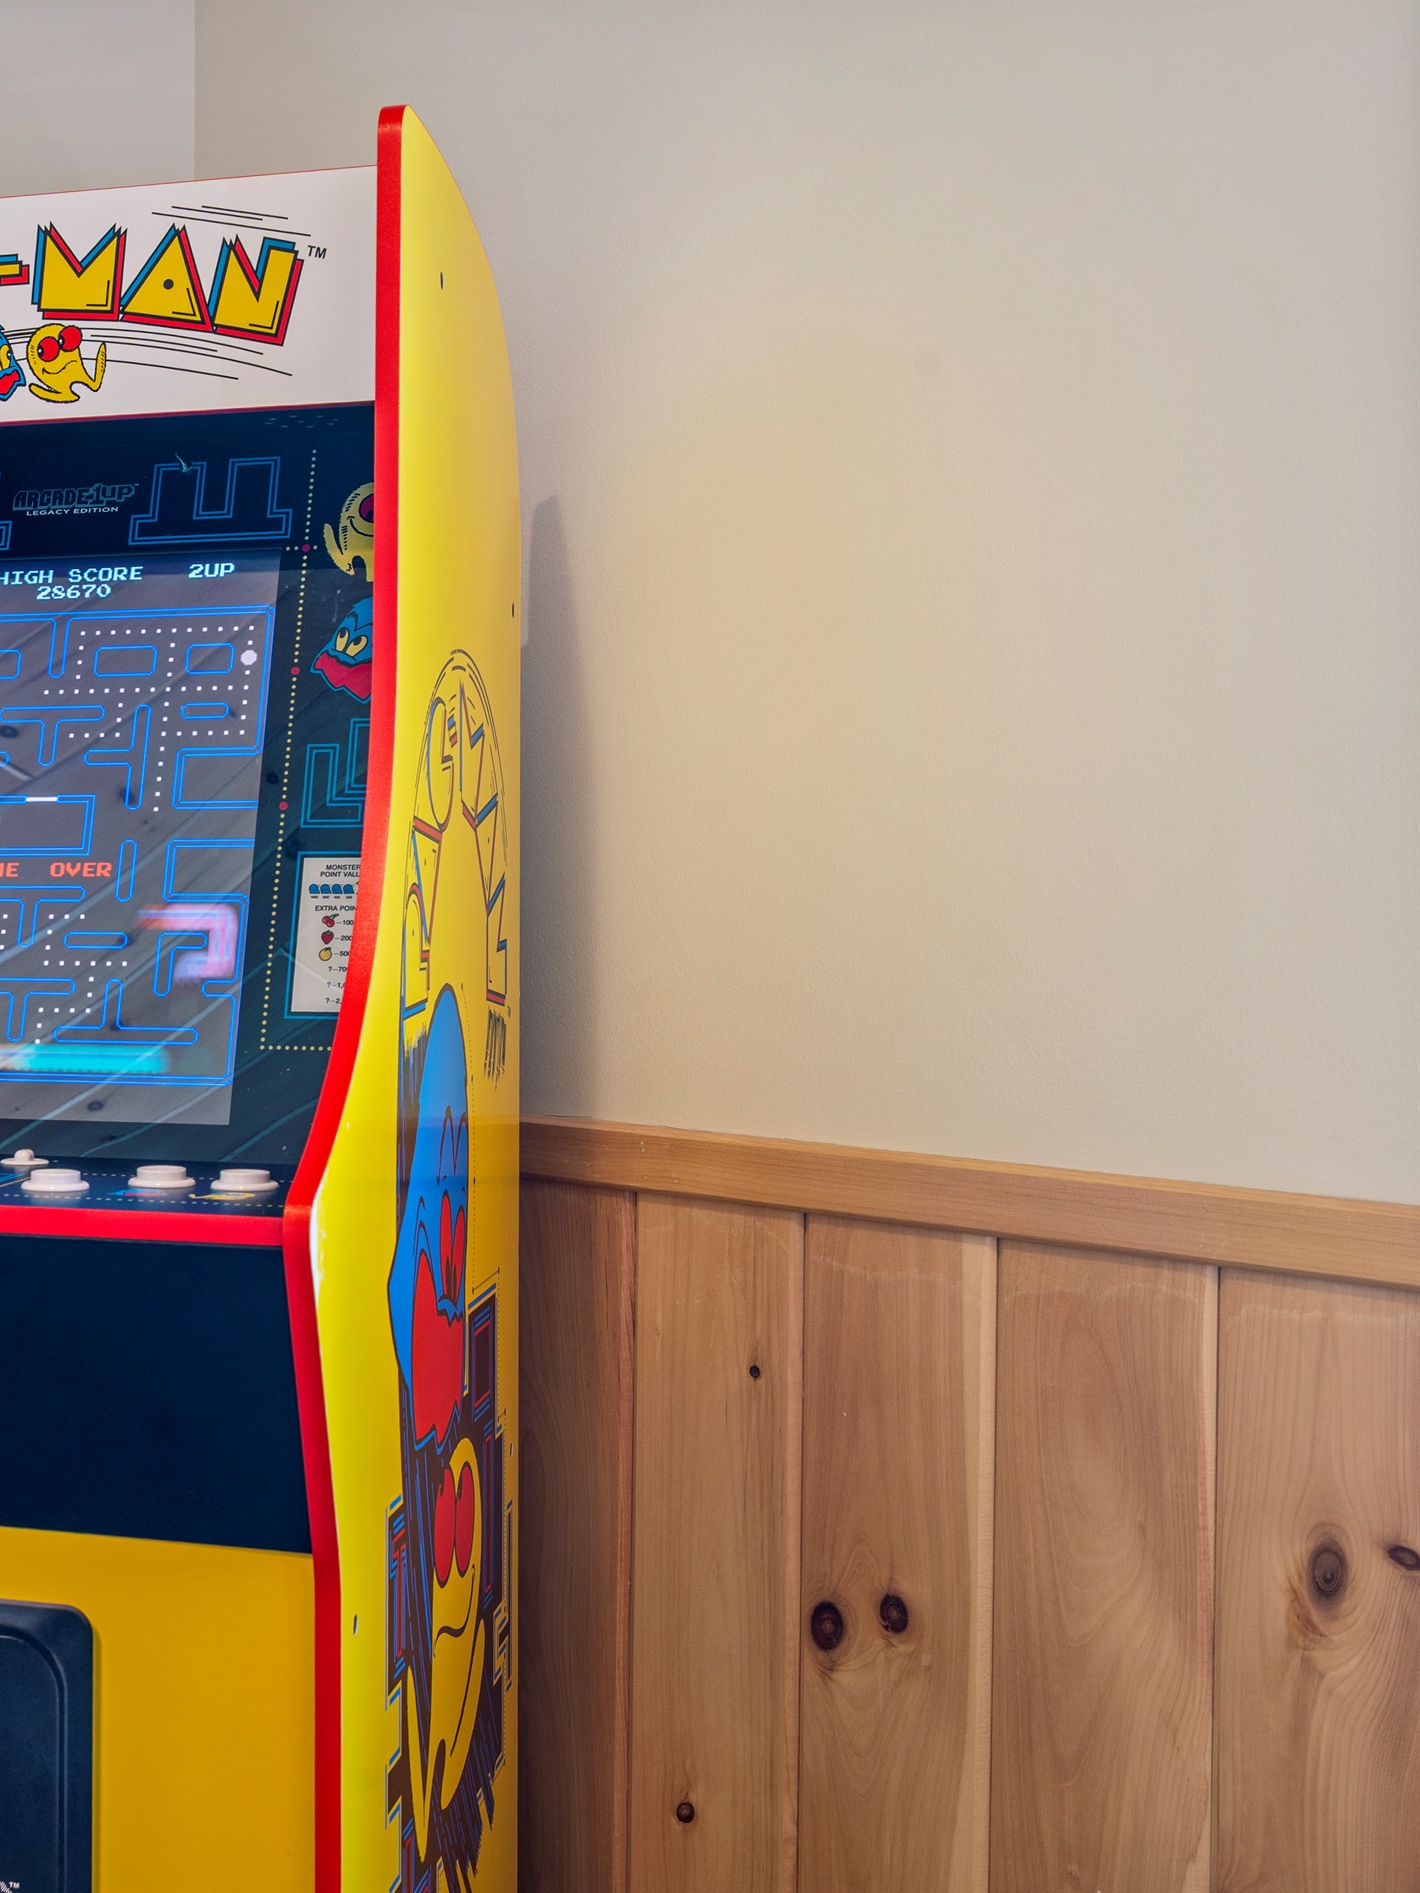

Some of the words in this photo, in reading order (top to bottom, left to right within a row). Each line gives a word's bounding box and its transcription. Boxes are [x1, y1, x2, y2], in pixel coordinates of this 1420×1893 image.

[26, 508, 70, 516] LEGACY
[73, 506, 119, 514] EDITION
[68, 566, 144, 582] SCORE
[188, 562, 236, 579] 2UP
[36, 583, 112, 601] 28670
[49, 862, 112, 878] OVER
